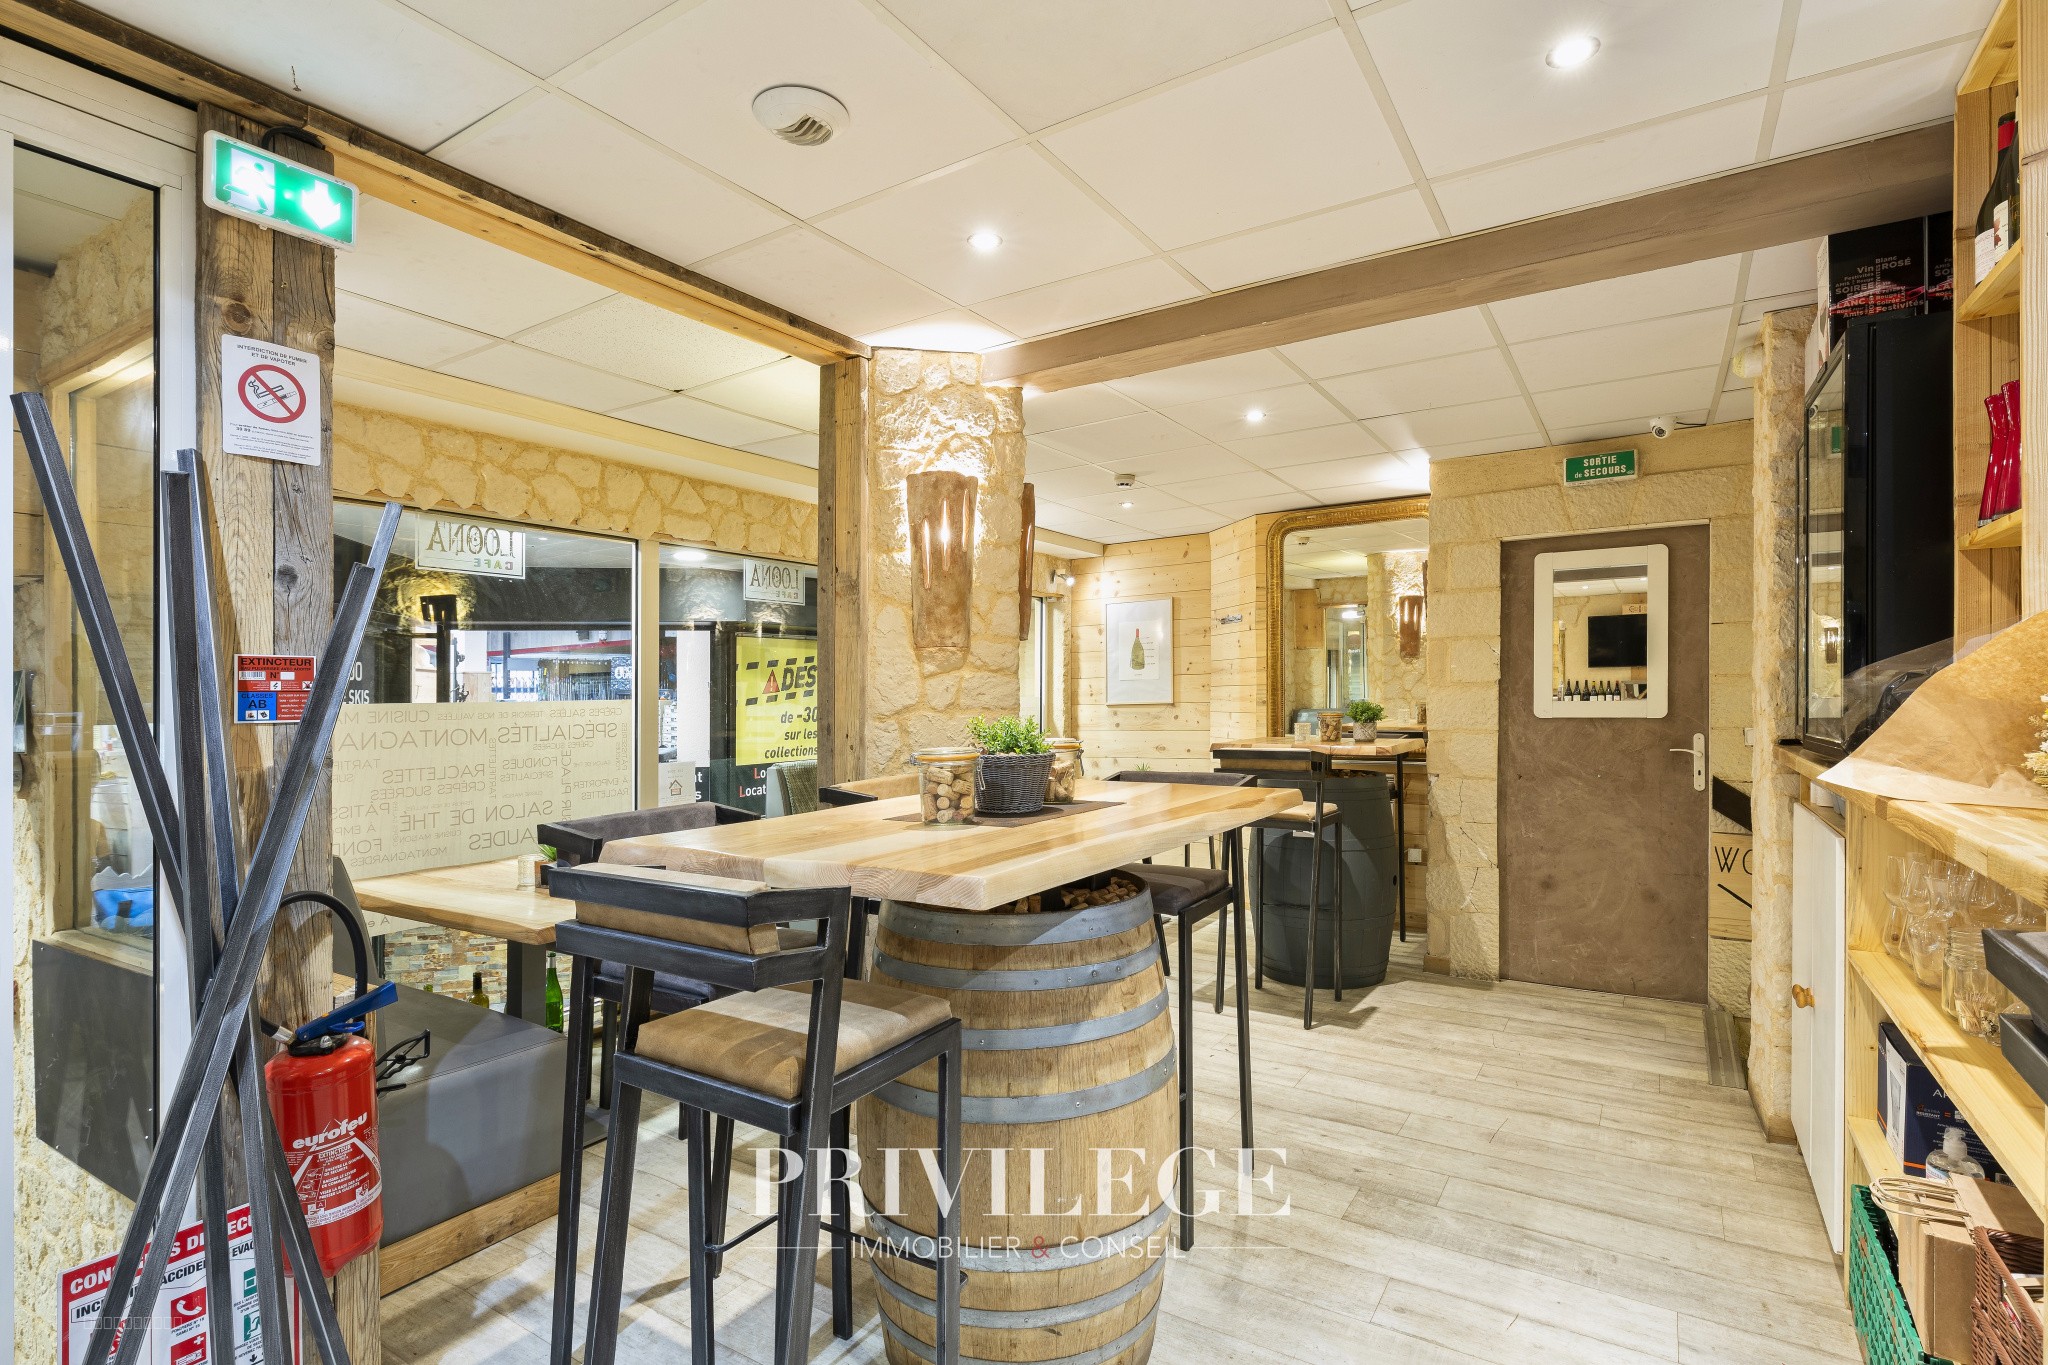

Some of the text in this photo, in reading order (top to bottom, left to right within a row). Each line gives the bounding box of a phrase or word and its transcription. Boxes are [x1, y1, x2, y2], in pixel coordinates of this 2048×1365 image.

[1856, 265, 1875, 274] Vin
[1881, 256, 1912, 270] ROSÉ
[1876, 300, 1925, 312] Festivités
[237, 344, 279, 357] INTERDICTION
[269, 356, 296, 366] VAPOTER
[1583, 455, 1618, 467] SORTIE
[1574, 471, 1583, 479] de
[1584, 464, 1627, 478] SECOURS
[240, 657, 312, 667] EXTINCTEUR
[348, 689, 370, 704] SKIS
[780, 706, 794, 724] de
[784, 728, 818, 741] sur les
[764, 745, 818, 760] collections
[293, 1112, 368, 1149] eurofeu
